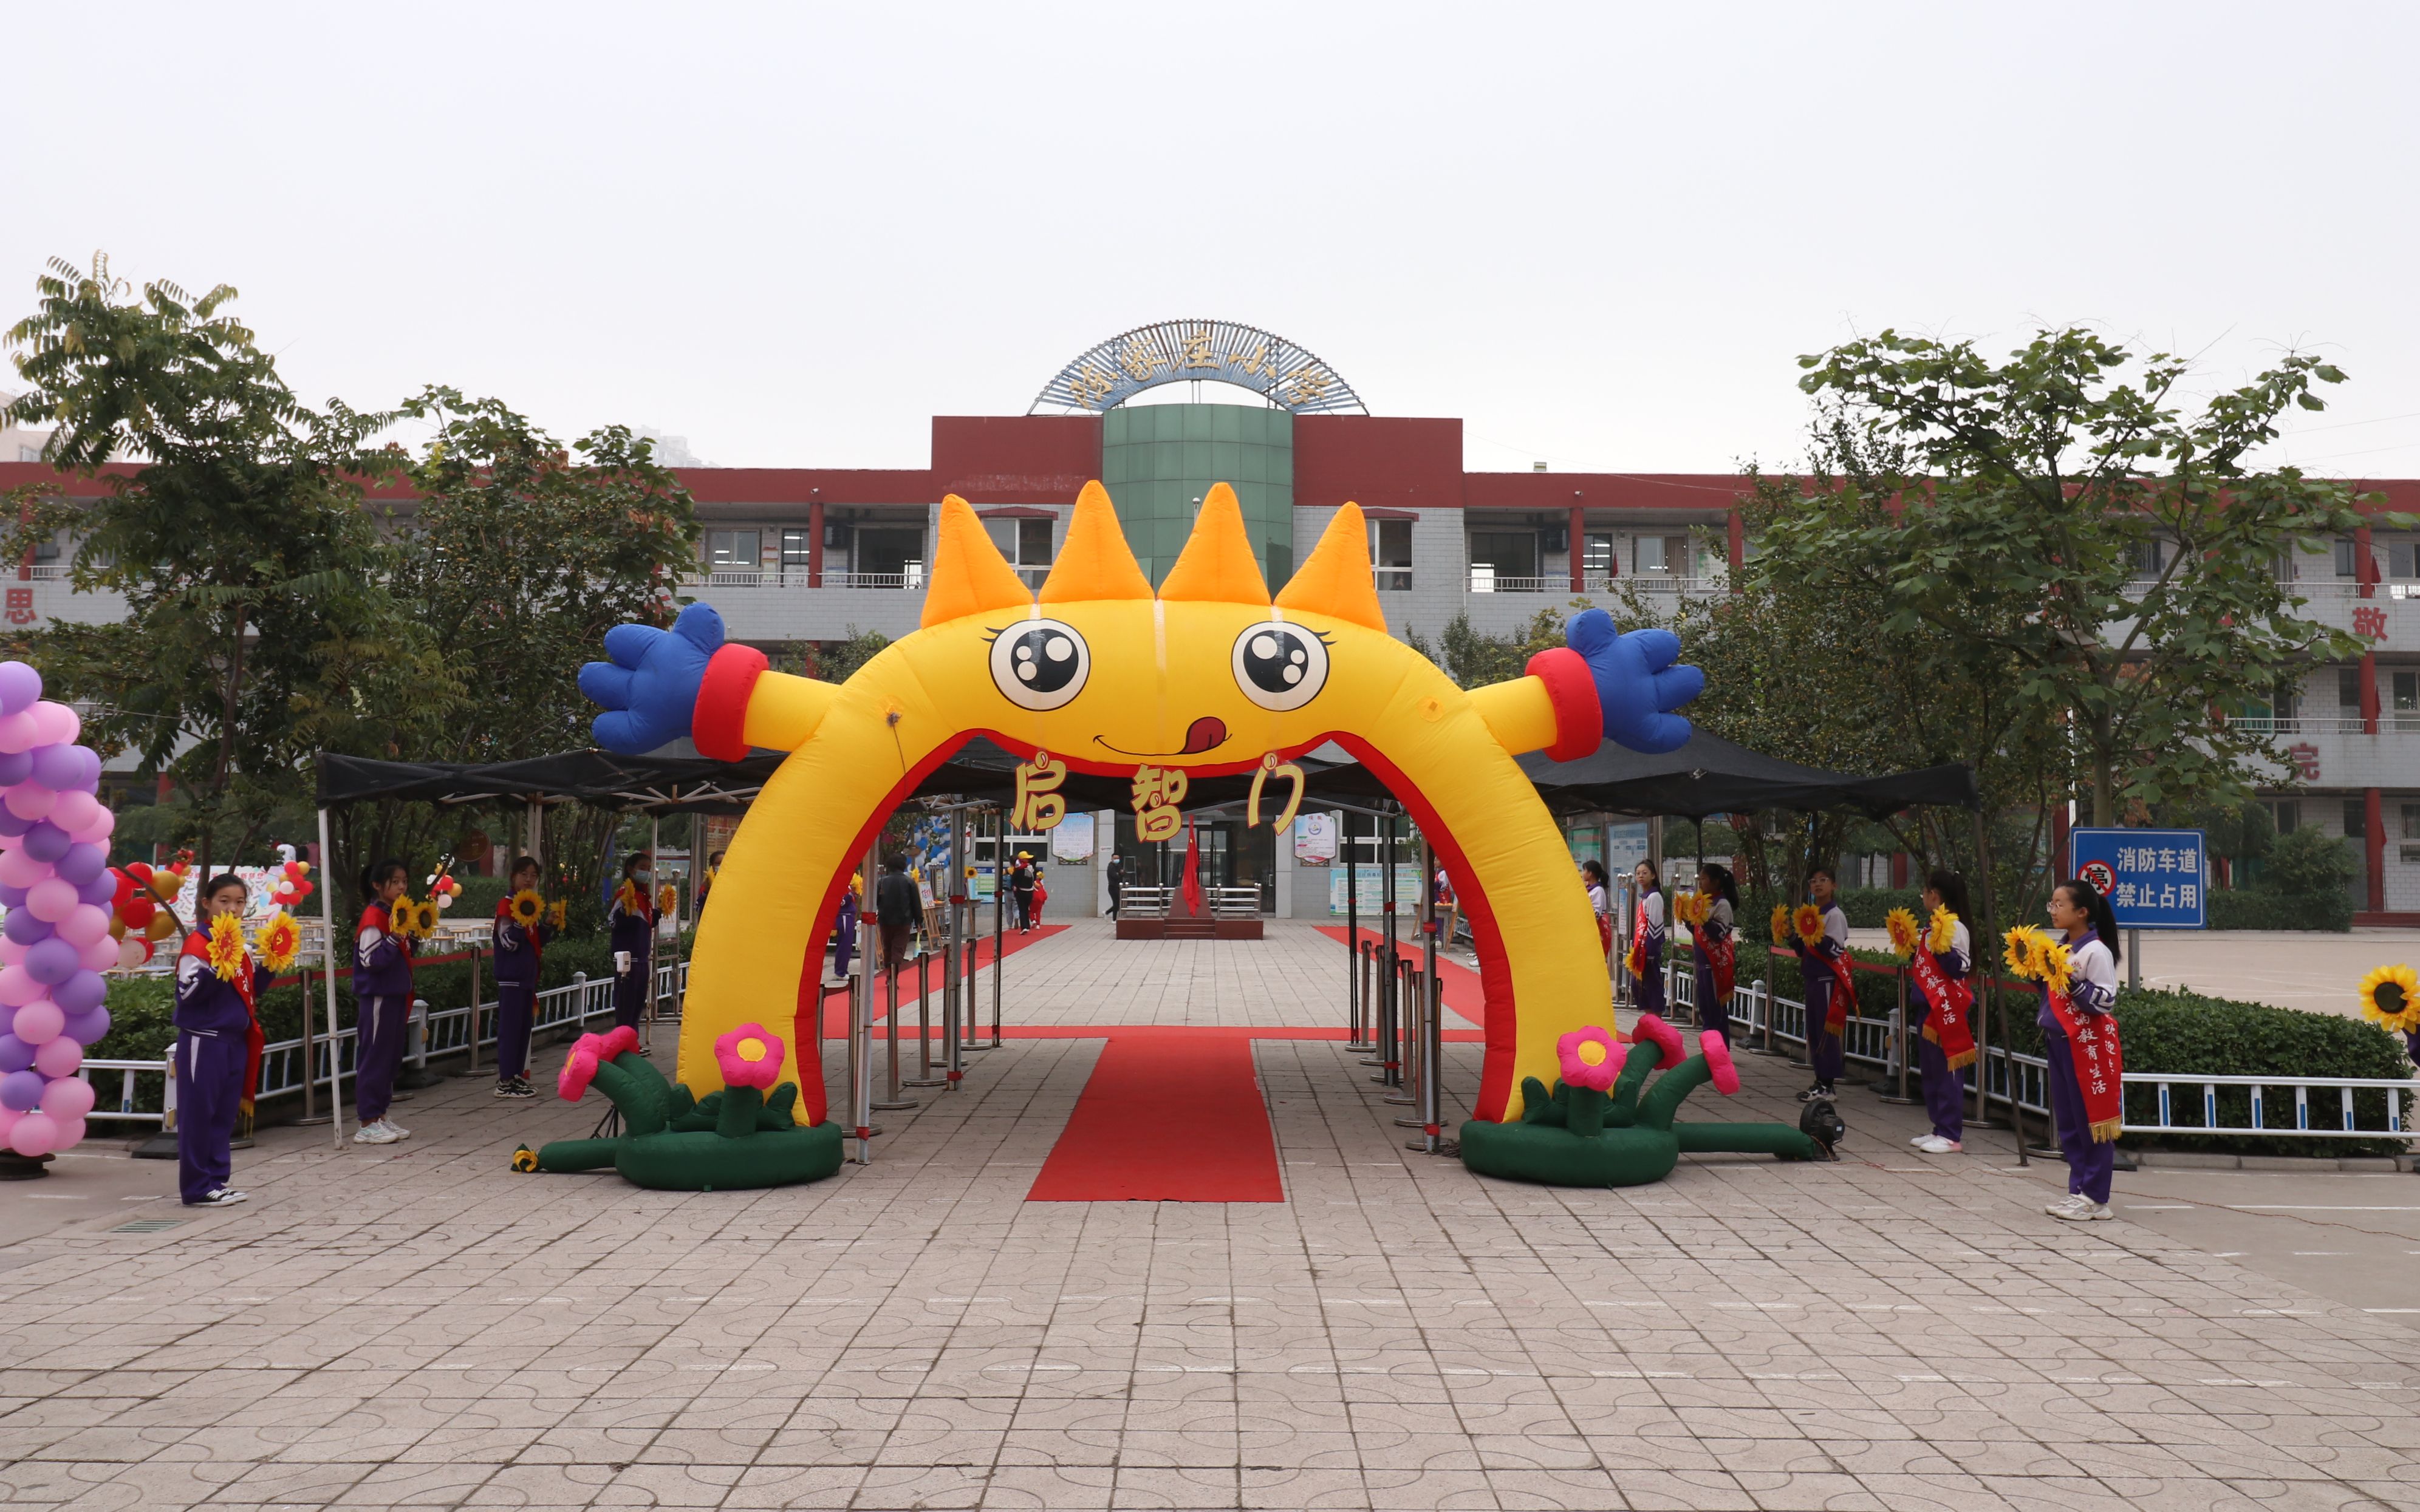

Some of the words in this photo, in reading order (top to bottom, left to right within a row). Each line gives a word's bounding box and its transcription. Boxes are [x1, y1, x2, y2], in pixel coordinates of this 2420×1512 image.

[4, 588, 36, 624] 思
[2353, 607, 2388, 642] 敬
[1010, 751, 1305, 843] 启智门
[2117, 846, 2197, 873] 消防车道
[2085, 867, 2108, 891] 停
[2116, 882, 2196, 908] 禁止占用
[1915, 948, 1956, 1025] 福的教育生活
